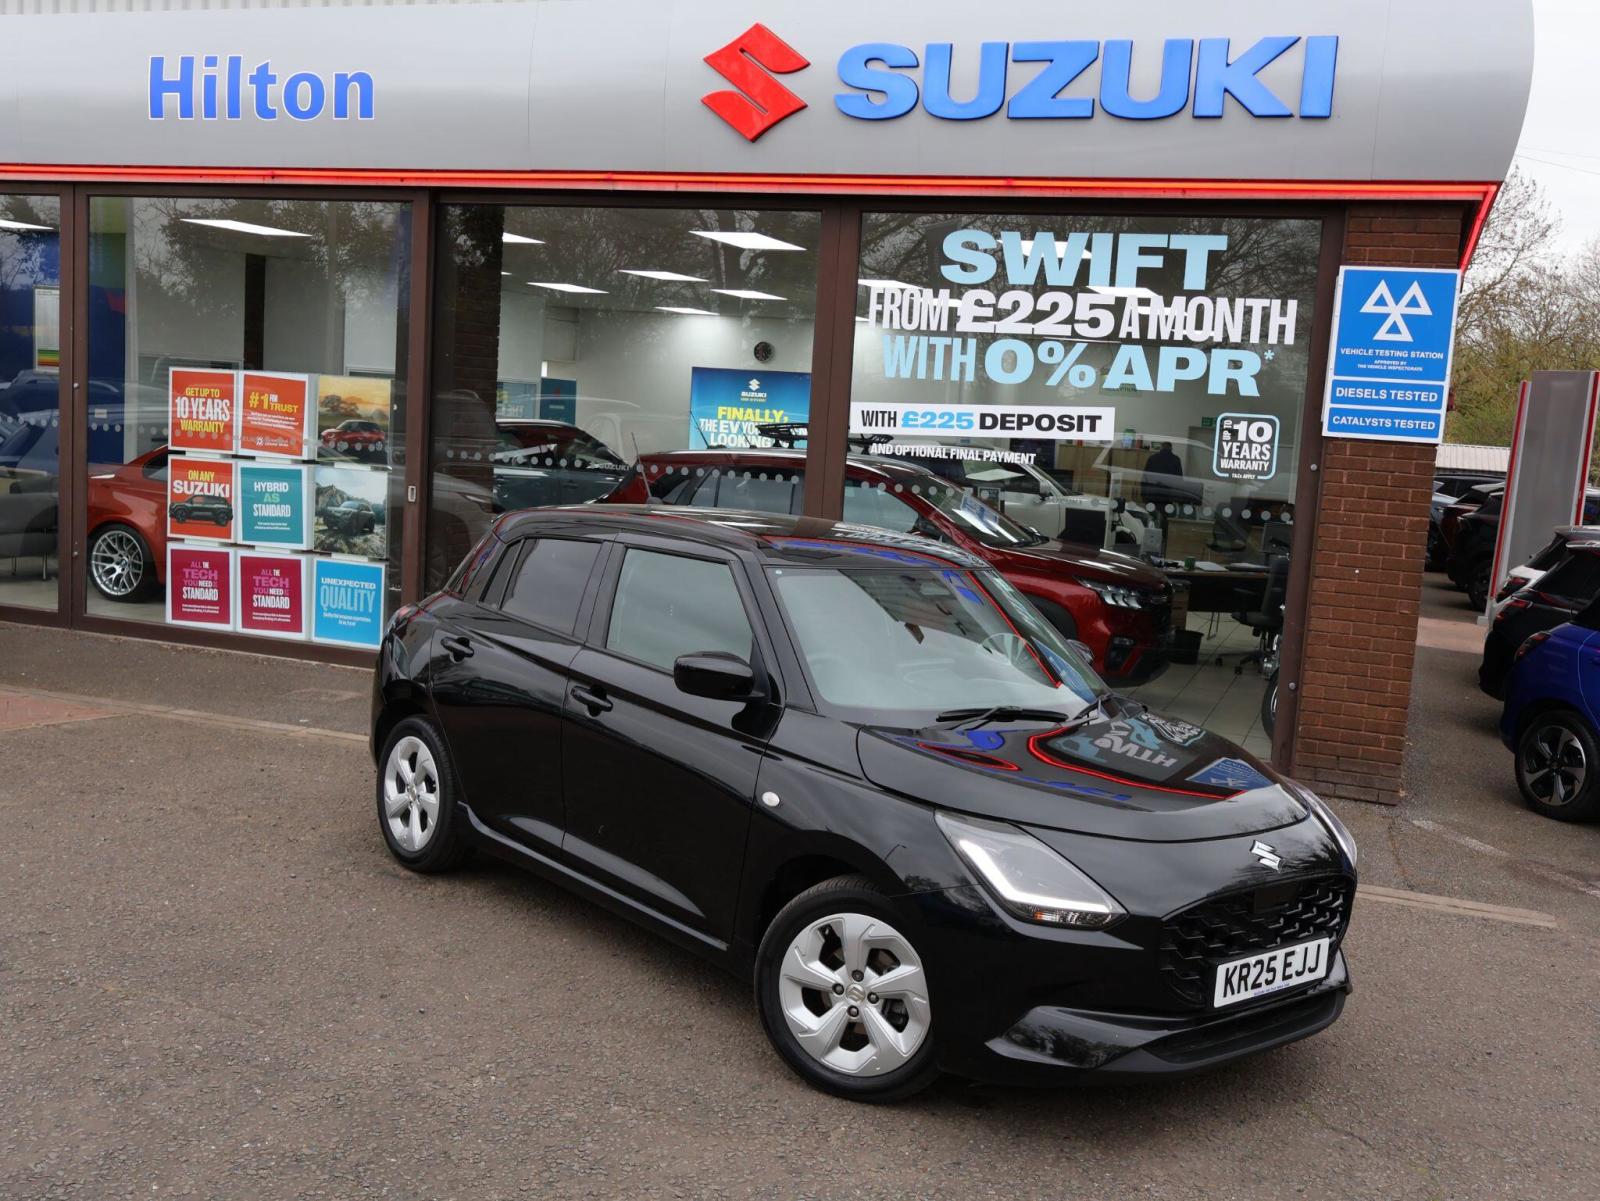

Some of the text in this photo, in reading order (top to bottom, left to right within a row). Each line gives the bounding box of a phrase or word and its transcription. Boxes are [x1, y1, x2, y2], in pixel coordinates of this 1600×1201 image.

[834, 36, 1338, 120] SUZUKI
[149, 55, 375, 120] Hilton
[941, 229, 1229, 291] SWIFT
[868, 287, 1298, 345] FROM £225 A MONTH
[882, 335, 976, 383] WITH
[984, 338, 1097, 389] 0%
[1375, 349, 1409, 358] TESTING
[1410, 351, 1444, 360] STATION
[185, 387, 220, 398] GET UP TO
[1336, 387, 1438, 402] DIESELS TESTED
[175, 396, 189, 419] 10
[190, 397, 230, 421] YEARS
[270, 402, 298, 413] TRUST
[717, 406, 788, 423] FINALLY,
[180, 419, 225, 432] WARRANTY
[699, 418, 718, 432] THE
[719, 419, 741, 433] EV
[861, 410, 1102, 432] WITH £225 DEPOSIT
[1332, 415, 1436, 430] CATALYSTS TESTED
[1222, 419, 1232, 440] UP TO
[1233, 420, 1273, 443] 10
[710, 432, 773, 448] LOOKING
[869, 442, 1036, 464] AND OPTIONAL FINAL PAYMENT
[1222, 442, 1271, 460] YEARS
[1220, 458, 1270, 471] WARRANTY
[188, 469, 215, 482] ON ANY
[173, 480, 230, 497] SUZUKI
[254, 481, 289, 492] HYBRID
[263, 493, 281, 503] AS
[253, 504, 291, 517] STANDARD
[183, 568, 218, 580] TECH
[253, 576, 289, 588] TECH
[321, 577, 376, 589] UNEXPECTED
[182, 586, 219, 600] STANDARD
[320, 585, 375, 612] QUALITY
[252, 594, 290, 609] STANDARD
[1223, 943, 1321, 998] KR25 EJJ
